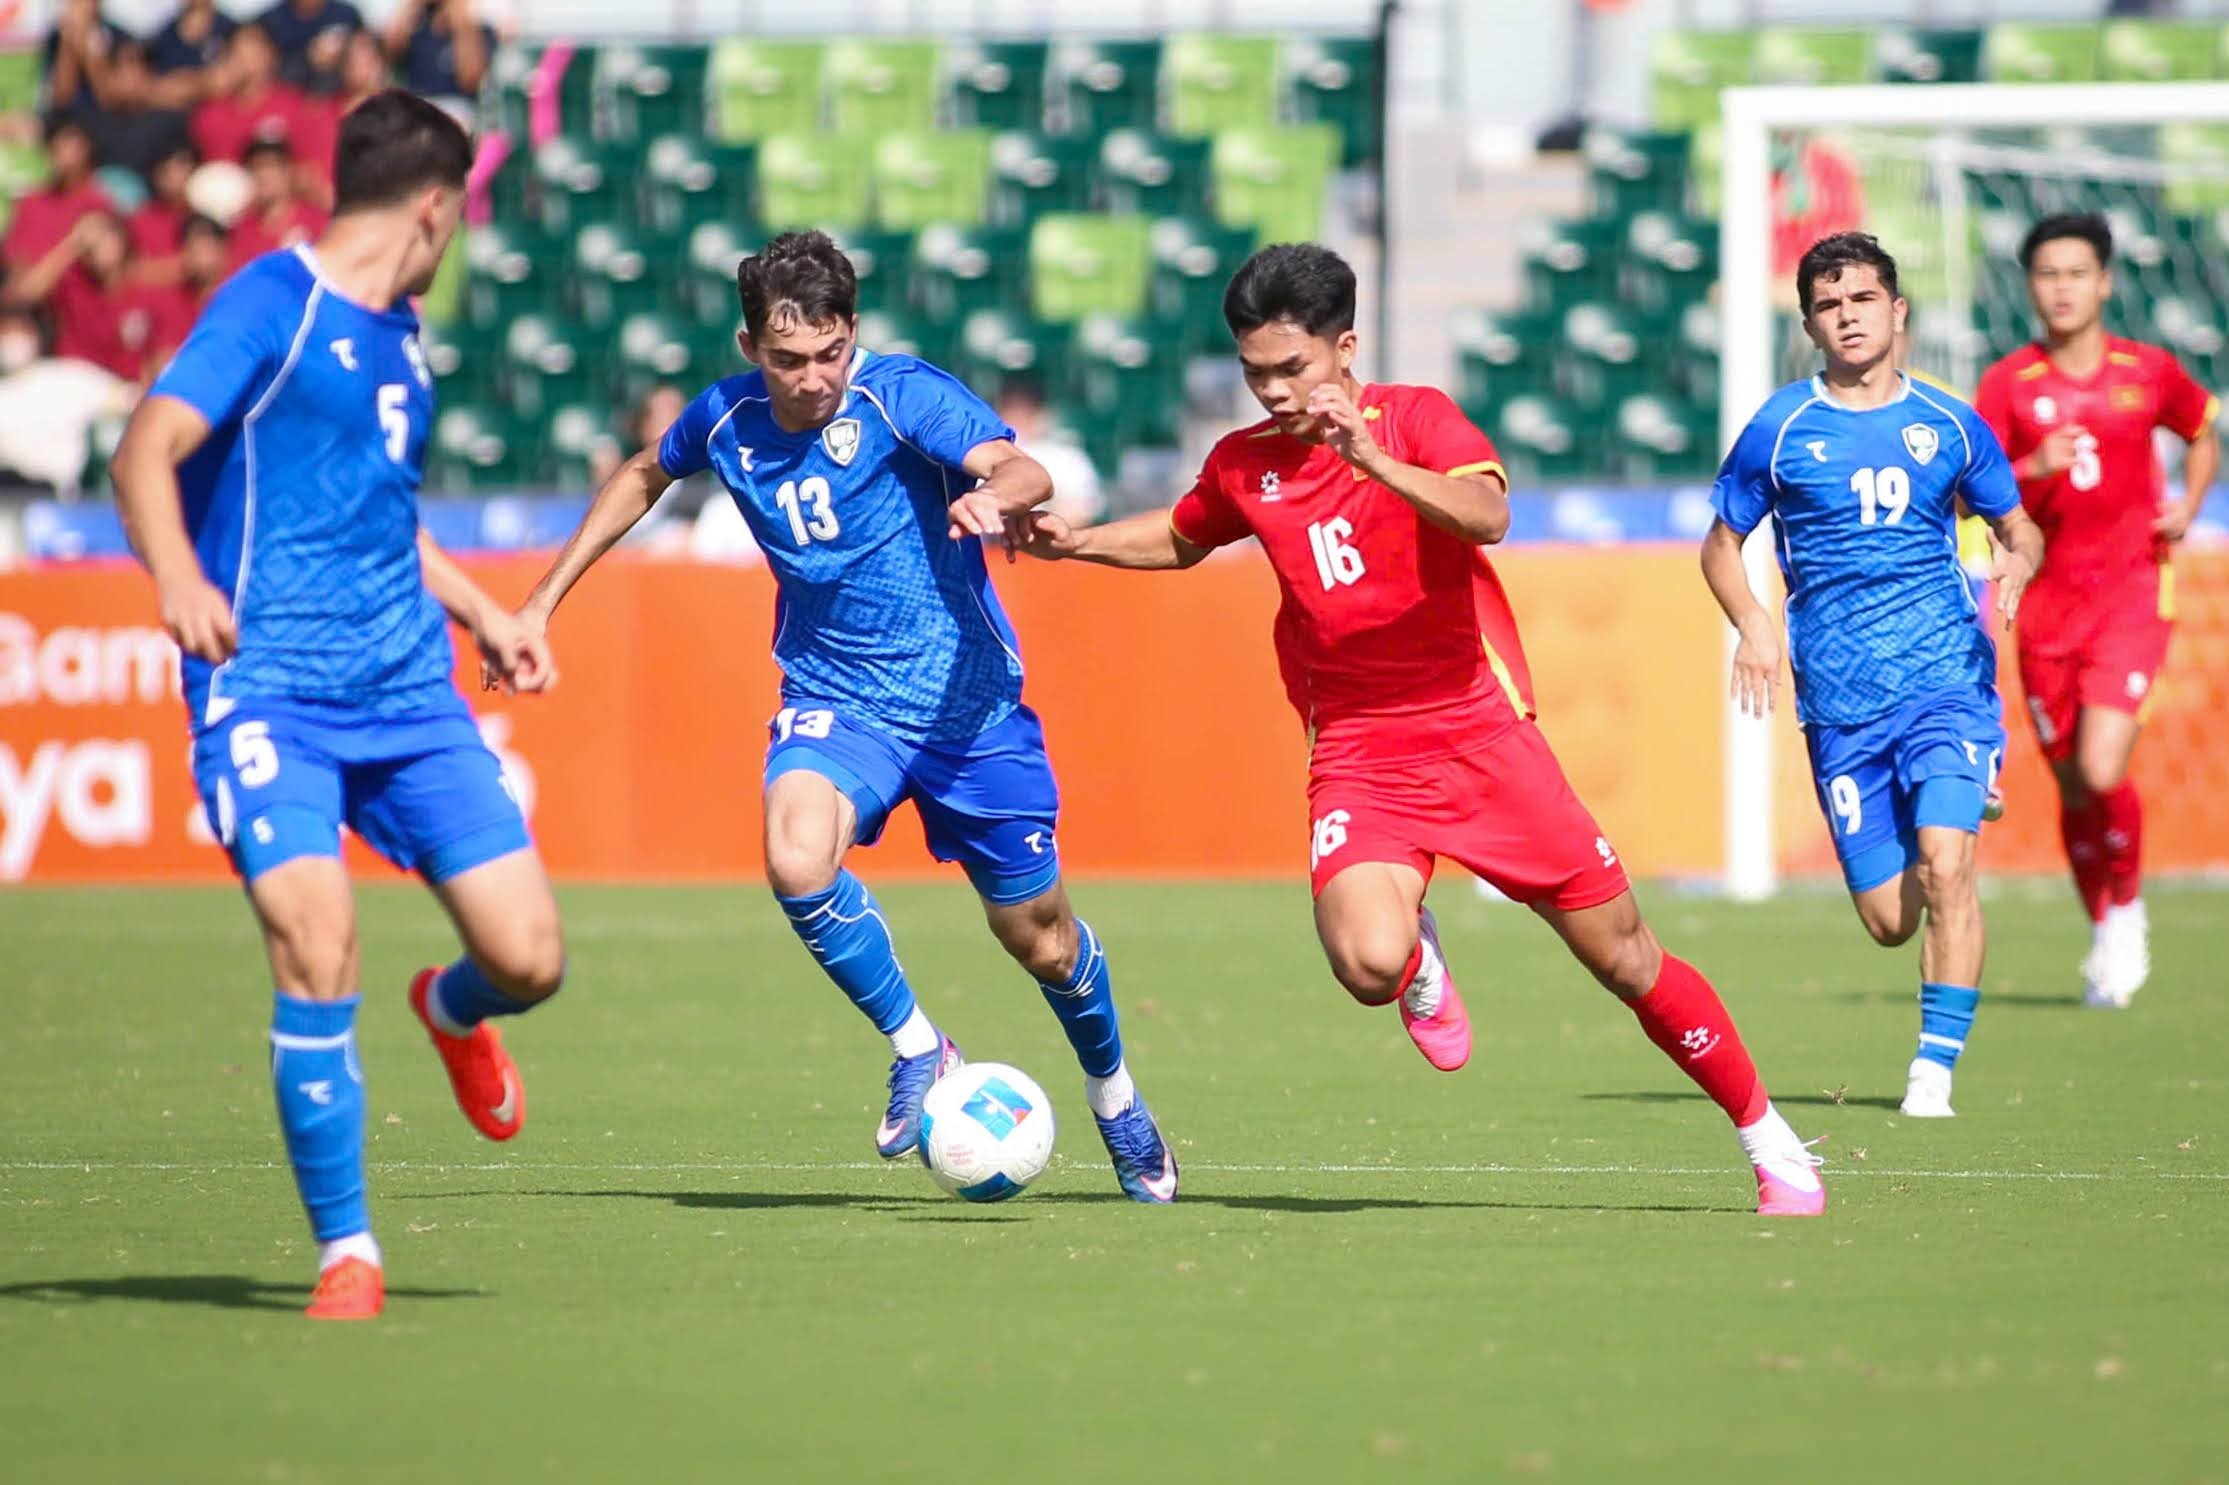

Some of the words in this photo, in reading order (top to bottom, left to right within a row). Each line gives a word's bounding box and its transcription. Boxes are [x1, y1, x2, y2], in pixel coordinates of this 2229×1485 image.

[378, 383, 410, 465] 5
[776, 476, 840, 546] 13
[1850, 466, 1910, 526] 19
[1307, 515, 1366, 592] 16
[229, 719, 280, 789] 5
[776, 707, 834, 745] 13
[1311, 808, 1351, 872] 16
